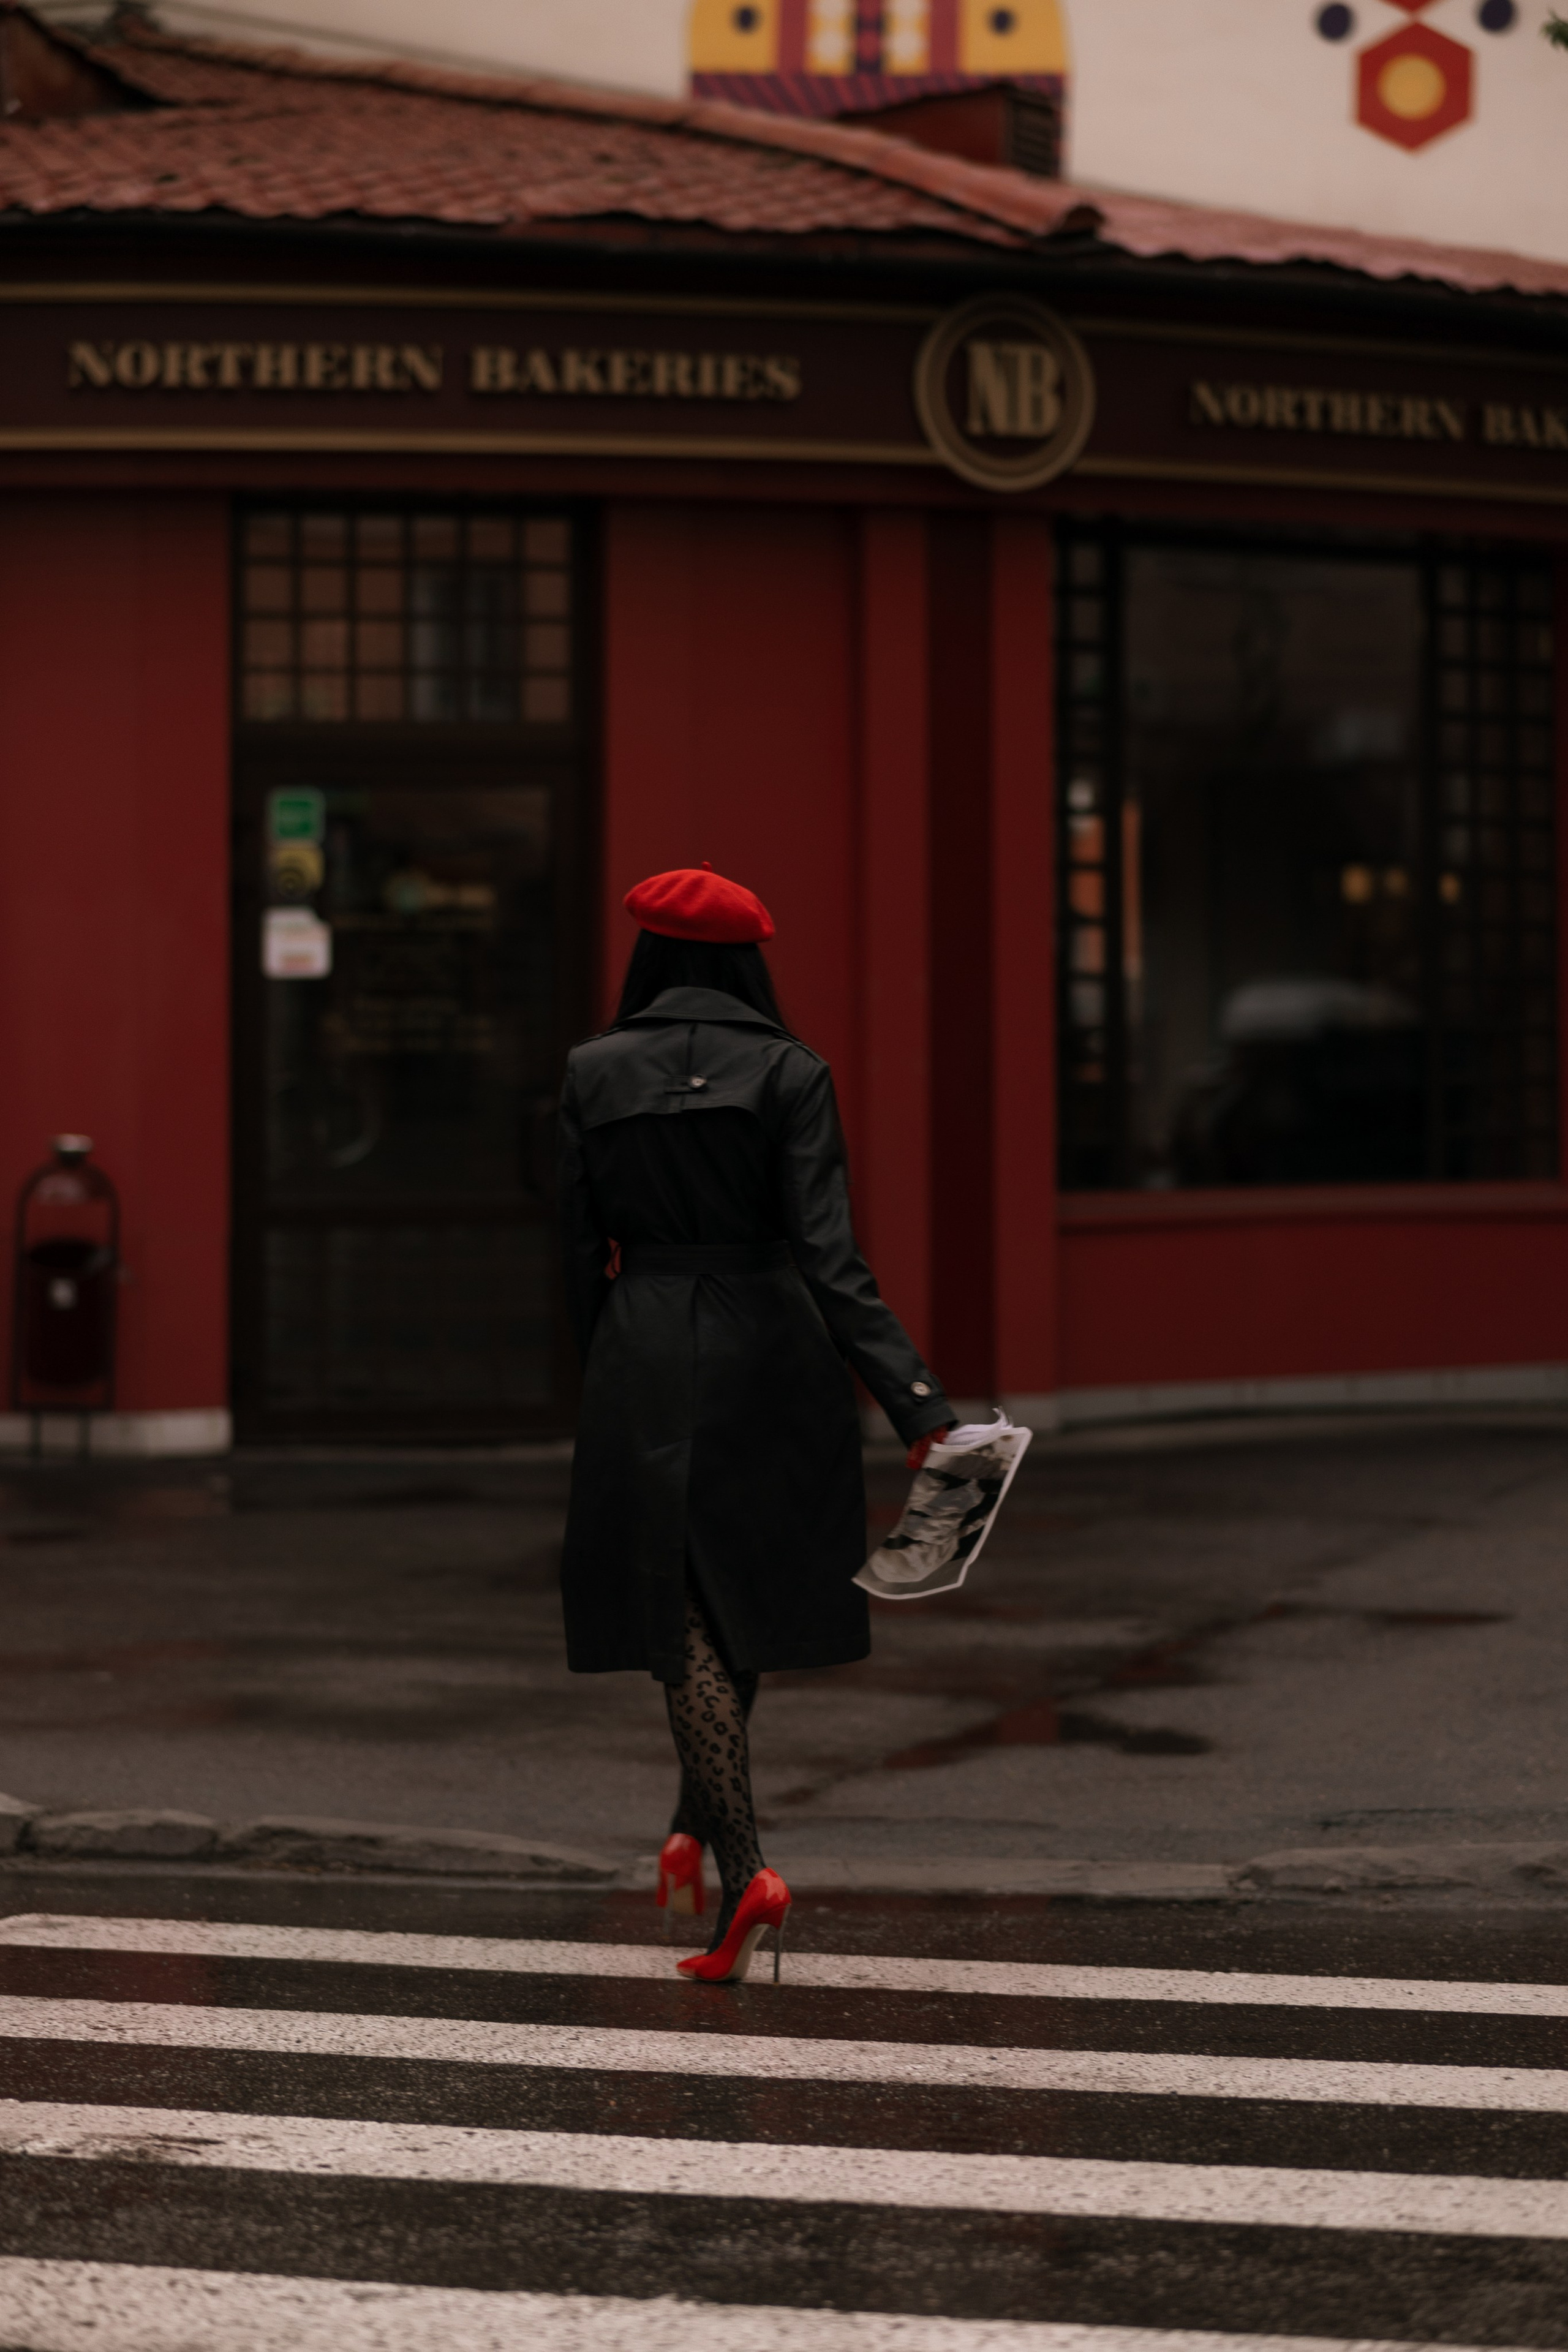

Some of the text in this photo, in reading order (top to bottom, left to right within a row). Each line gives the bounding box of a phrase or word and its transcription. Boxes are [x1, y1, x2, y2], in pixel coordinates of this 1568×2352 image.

[68, 339, 802, 401] NORTHERN BAKERIES
[964, 339, 1063, 439] NB
[1190, 379, 1465, 442] NORTHERN
